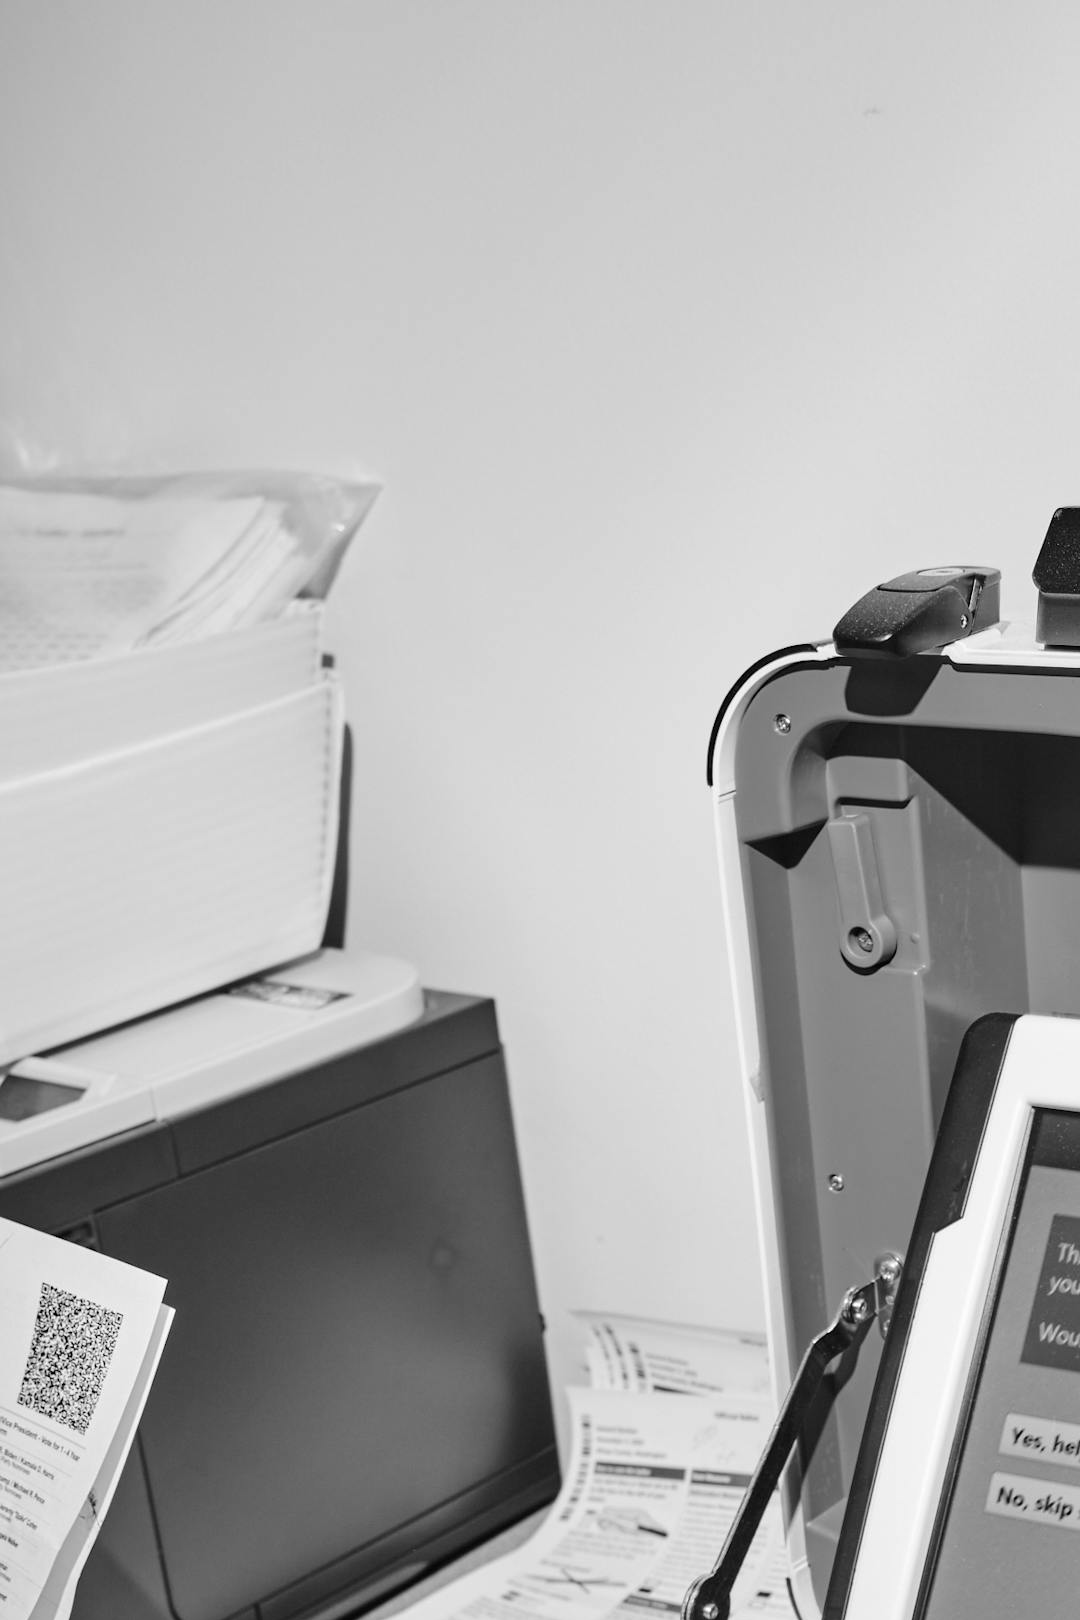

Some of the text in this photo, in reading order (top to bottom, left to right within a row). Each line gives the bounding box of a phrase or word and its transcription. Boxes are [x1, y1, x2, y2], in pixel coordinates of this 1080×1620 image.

[1012, 1427, 1046, 1454] Yes,
[996, 1487, 1028, 1511] No,
[1034, 1493, 1073, 1520] skip
